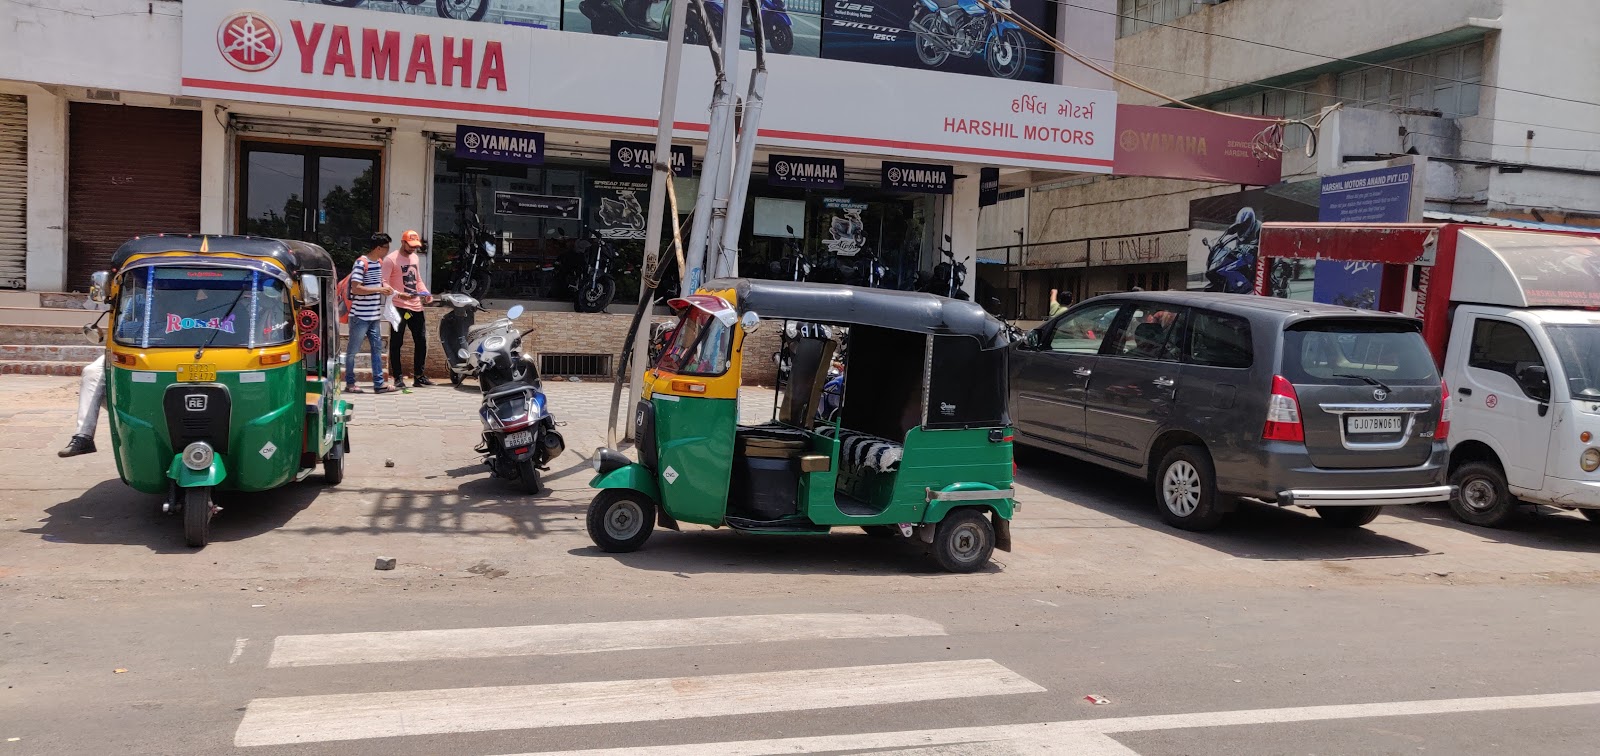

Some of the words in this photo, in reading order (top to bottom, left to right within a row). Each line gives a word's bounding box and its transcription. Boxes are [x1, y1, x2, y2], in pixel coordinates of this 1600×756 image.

[834, 1, 874, 13] UBS
[873, 33, 897, 42] 125CC
[290, 19, 508, 92] YAMAHA
[1011, 94, 1047, 115] હર્ષિલ
[1057, 99, 1096, 120] મોટર્સ
[944, 117, 1019, 139] HARSHIL
[1023, 125, 1095, 146] MOTORS
[481, 134, 537, 154] YAMAHA
[1140, 132, 1208, 156] YAMAHA
[469, 148, 533, 159] RACING
[633, 149, 686, 167] YAMHA
[622, 163, 682, 172] RACG
[789, 162, 838, 179] YAMAHA
[780, 176, 834, 184] RACING
[901, 168, 947, 185] YAMAHA
[1321, 181, 1344, 192] HARSHIL
[1344, 178, 1367, 189] MOTORS
[1367, 176, 1386, 186] ANAND
[1386, 173, 1399, 184] PVT
[1398, 172, 1409, 182] LTD
[892, 182, 944, 190] RACING
[1415, 266, 1431, 320] YAMAHA
[165, 312, 236, 334] RONAK
[188, 400, 204, 408] RE
